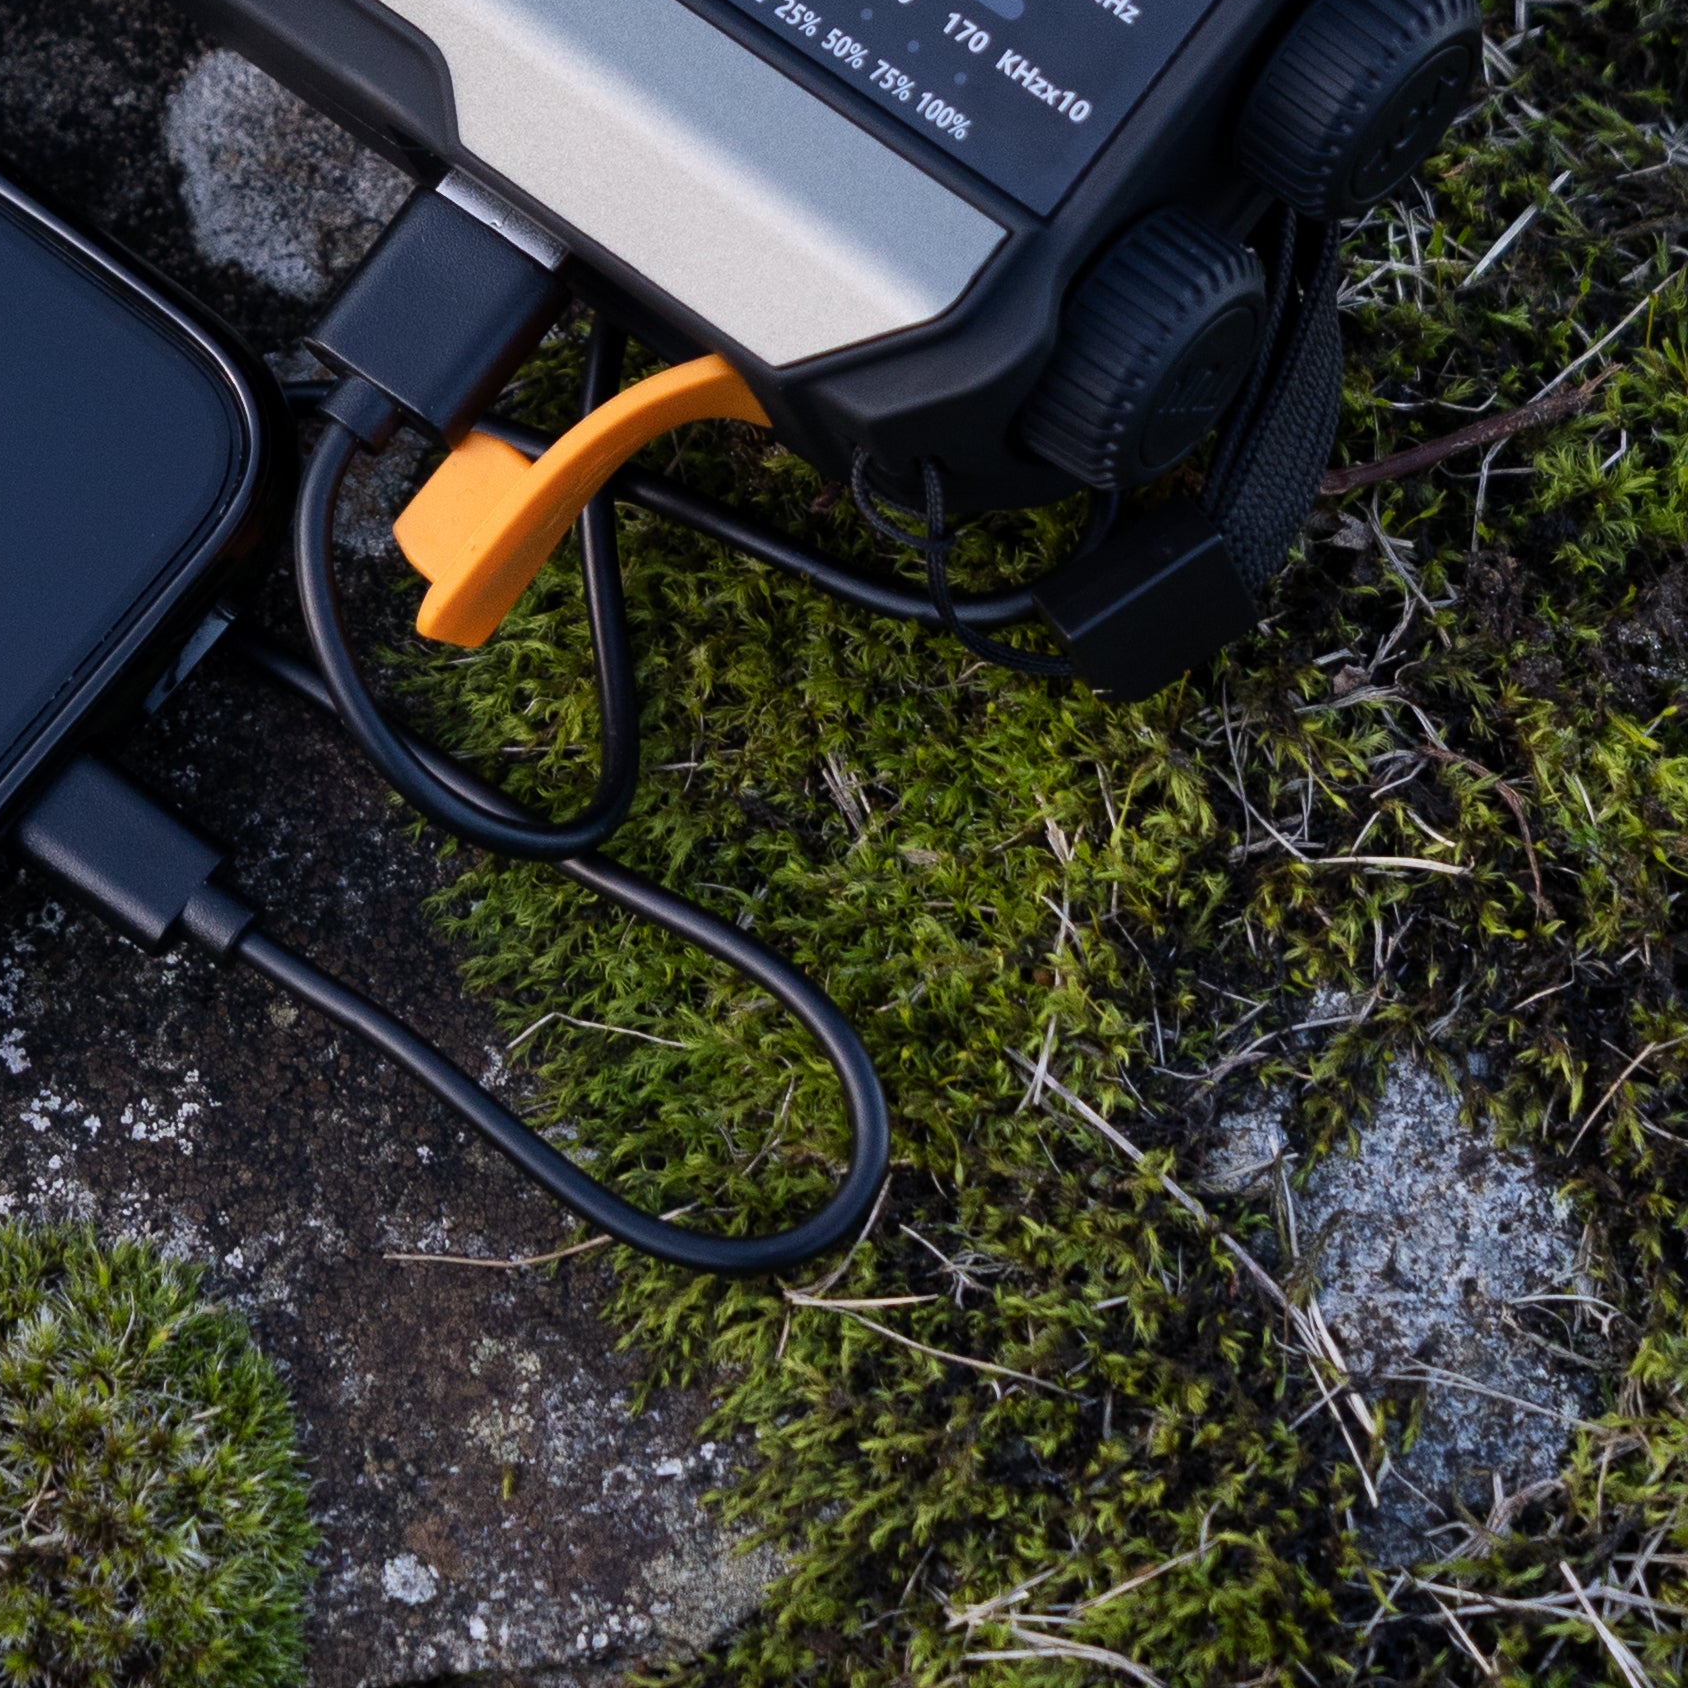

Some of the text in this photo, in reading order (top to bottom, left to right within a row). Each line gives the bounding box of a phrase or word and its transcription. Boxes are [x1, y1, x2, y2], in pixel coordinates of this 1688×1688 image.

[821, 27, 869, 70] 50%
[869, 59, 916, 102] 75%
[915, 91, 972, 141] 100%
[943, 12, 990, 53] 170
[995, 48, 1091, 122] KHzx10
